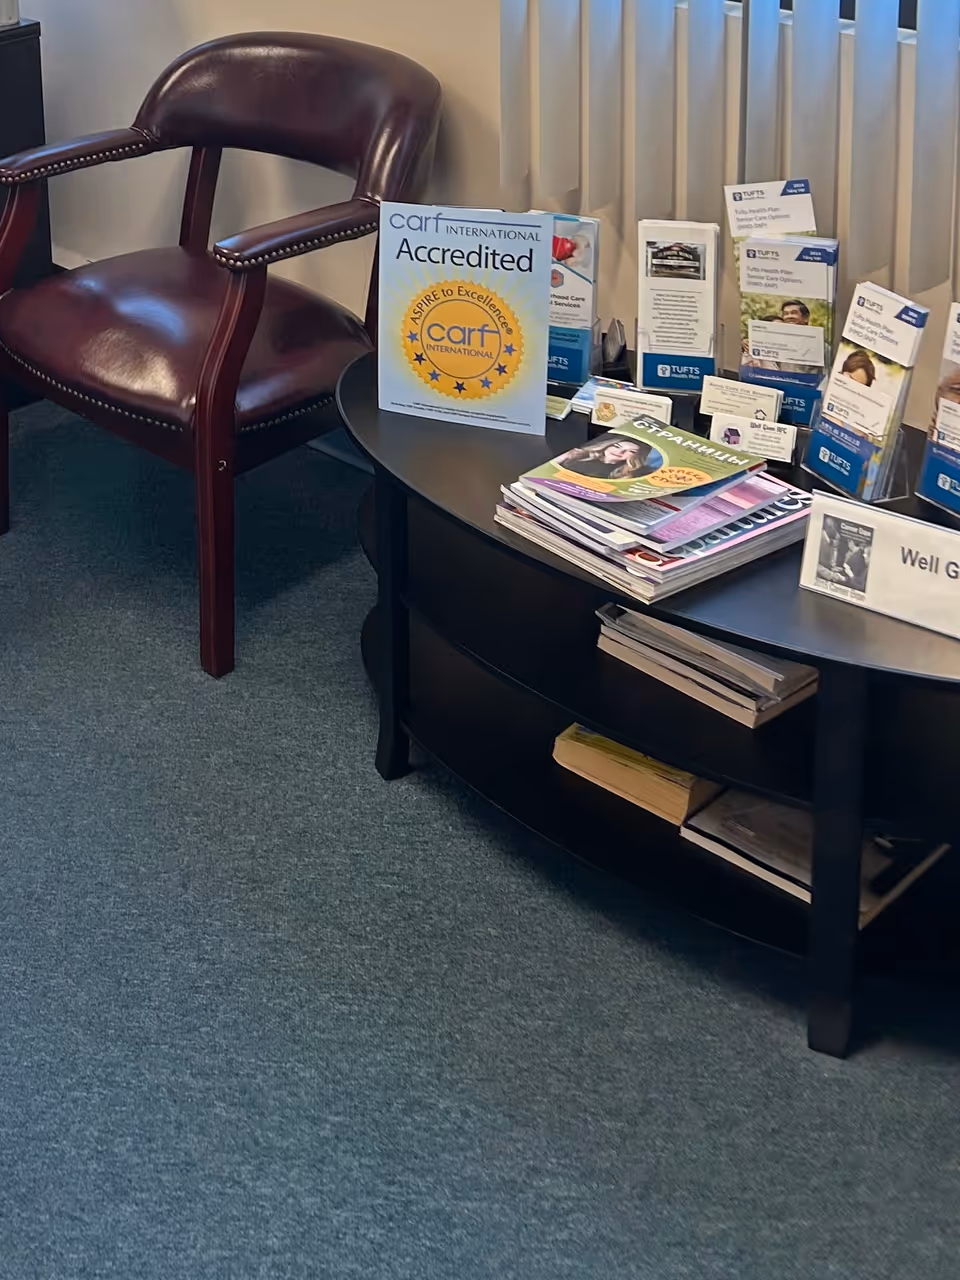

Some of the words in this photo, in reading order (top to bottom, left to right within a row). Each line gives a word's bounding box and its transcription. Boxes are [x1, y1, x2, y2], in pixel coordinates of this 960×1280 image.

[743, 190, 765, 198] TUFTS
[389, 212, 443, 234] carf
[445, 224, 542, 242] INTERNATIONAL
[395, 237, 534, 273] Accredited
[757, 249, 780, 258] TUFTS
[410, 290, 440, 326] ASPIRE
[442, 288, 454, 297] to
[554, 300, 581, 308] Services
[865, 298, 884, 312] TUFTS
[427, 323, 500, 348] carf
[426, 343, 495, 360] INTERNATIONAL
[548, 355, 569, 365] UFTS
[671, 365, 700, 375] TUFTS
[782, 397, 806, 407] UFTS
[632, 420, 750, 466] СТРАНИЦЫ
[829, 451, 852, 471] TUFTS
[900, 546, 940, 575] Well
